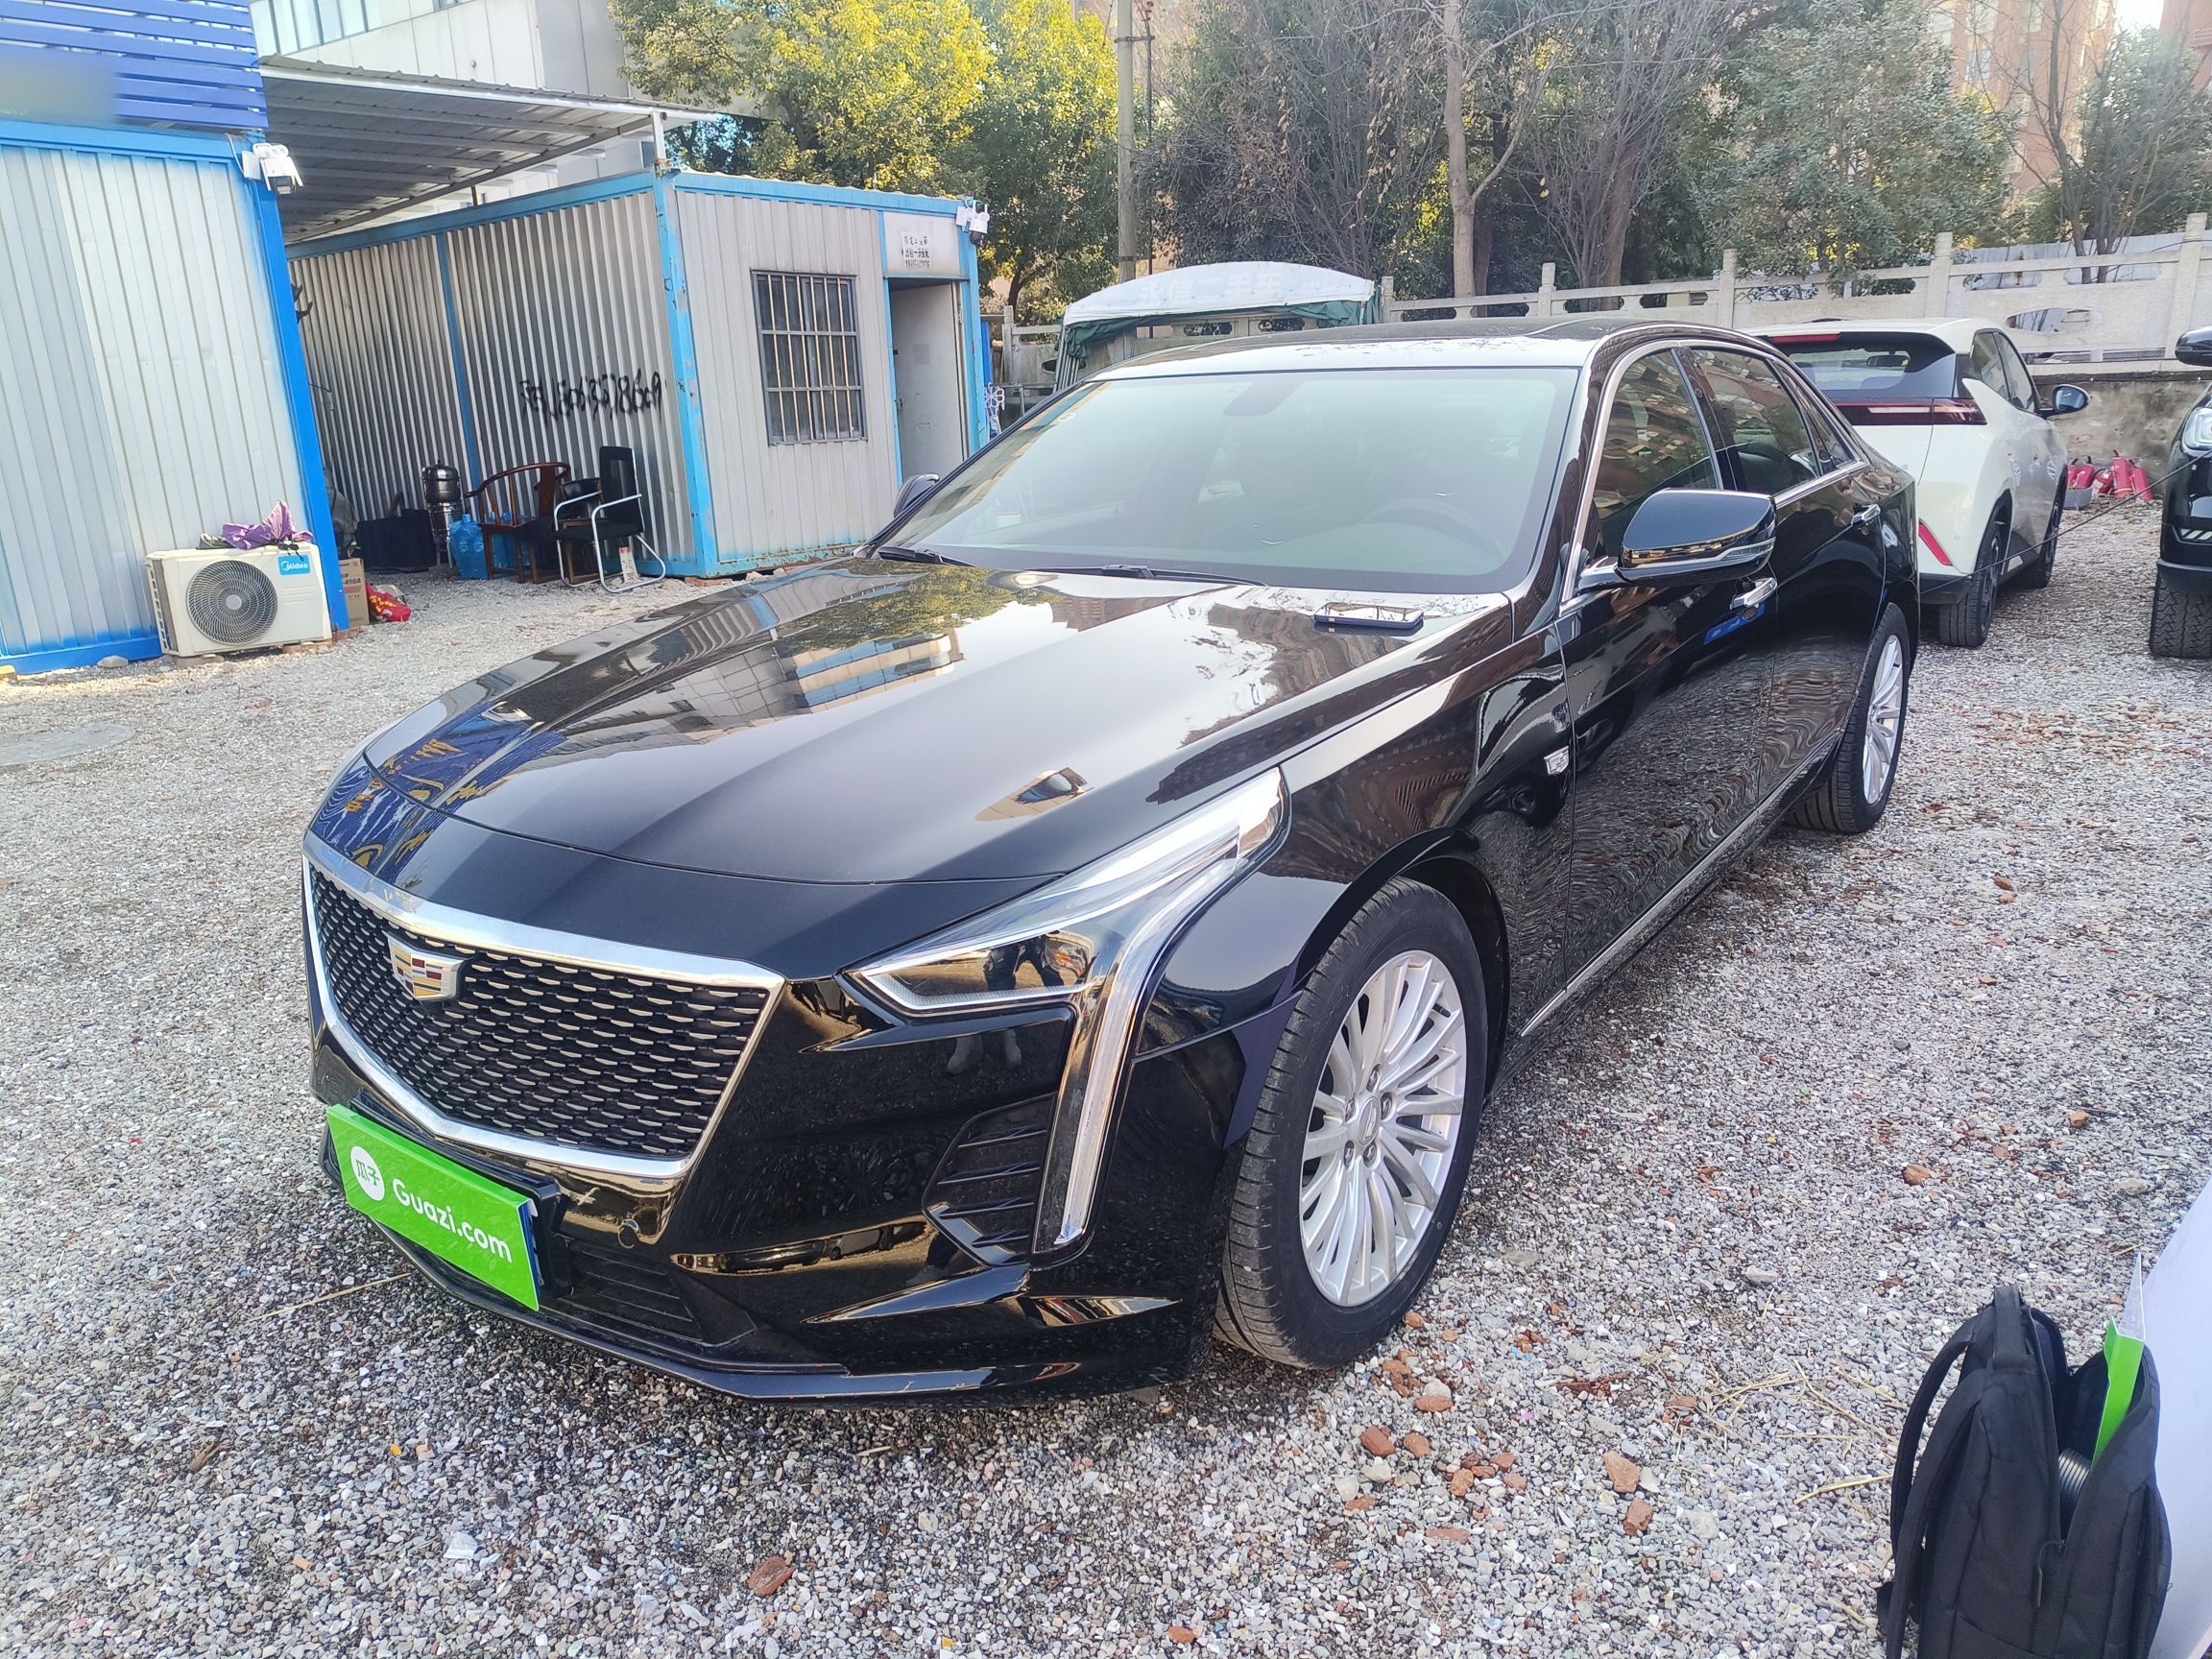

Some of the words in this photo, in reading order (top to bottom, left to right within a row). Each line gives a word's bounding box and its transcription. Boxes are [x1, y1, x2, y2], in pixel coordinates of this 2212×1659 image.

[280, 560, 308, 570] Midea
[355, 1160, 380, 1187] 瓜子
[393, 1178, 513, 1263] Guazi.com
